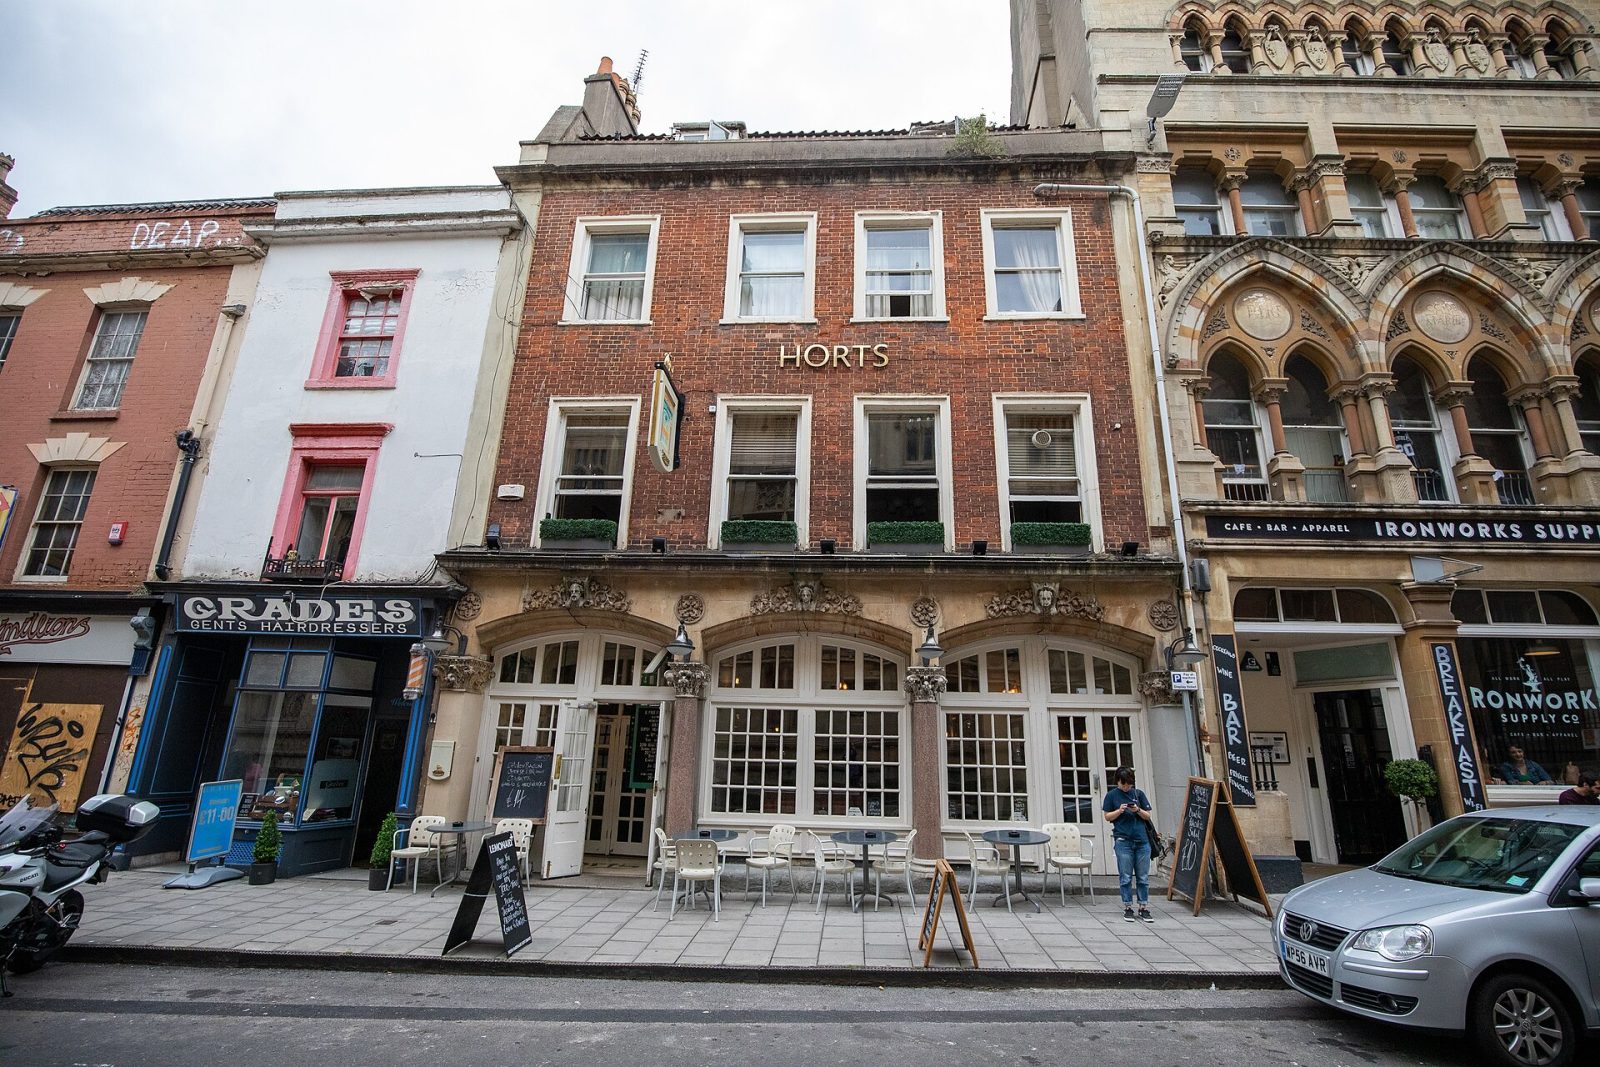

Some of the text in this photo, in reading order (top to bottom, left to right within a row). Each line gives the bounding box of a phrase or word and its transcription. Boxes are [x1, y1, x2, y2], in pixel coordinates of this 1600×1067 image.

[779, 343, 889, 368] HORTS
[1224, 523, 1350, 533] CAFE BAR APPAREL
[1374, 521, 1523, 539] IRONWORKS
[183, 597, 416, 623] GRADES
[190, 619, 407, 634] GENTS HAIRDRESSERS
[1216, 666, 1233, 679] WINE
[1222, 692, 1242, 746] BAR
[1500, 713, 1557, 724] SUPPLY
[1227, 751, 1247, 766] BEER
[1229, 768, 1249, 783] PRIVATE
[19, 872, 39, 883] DUCATI
[1285, 944, 1327, 973] WP56 AVR
